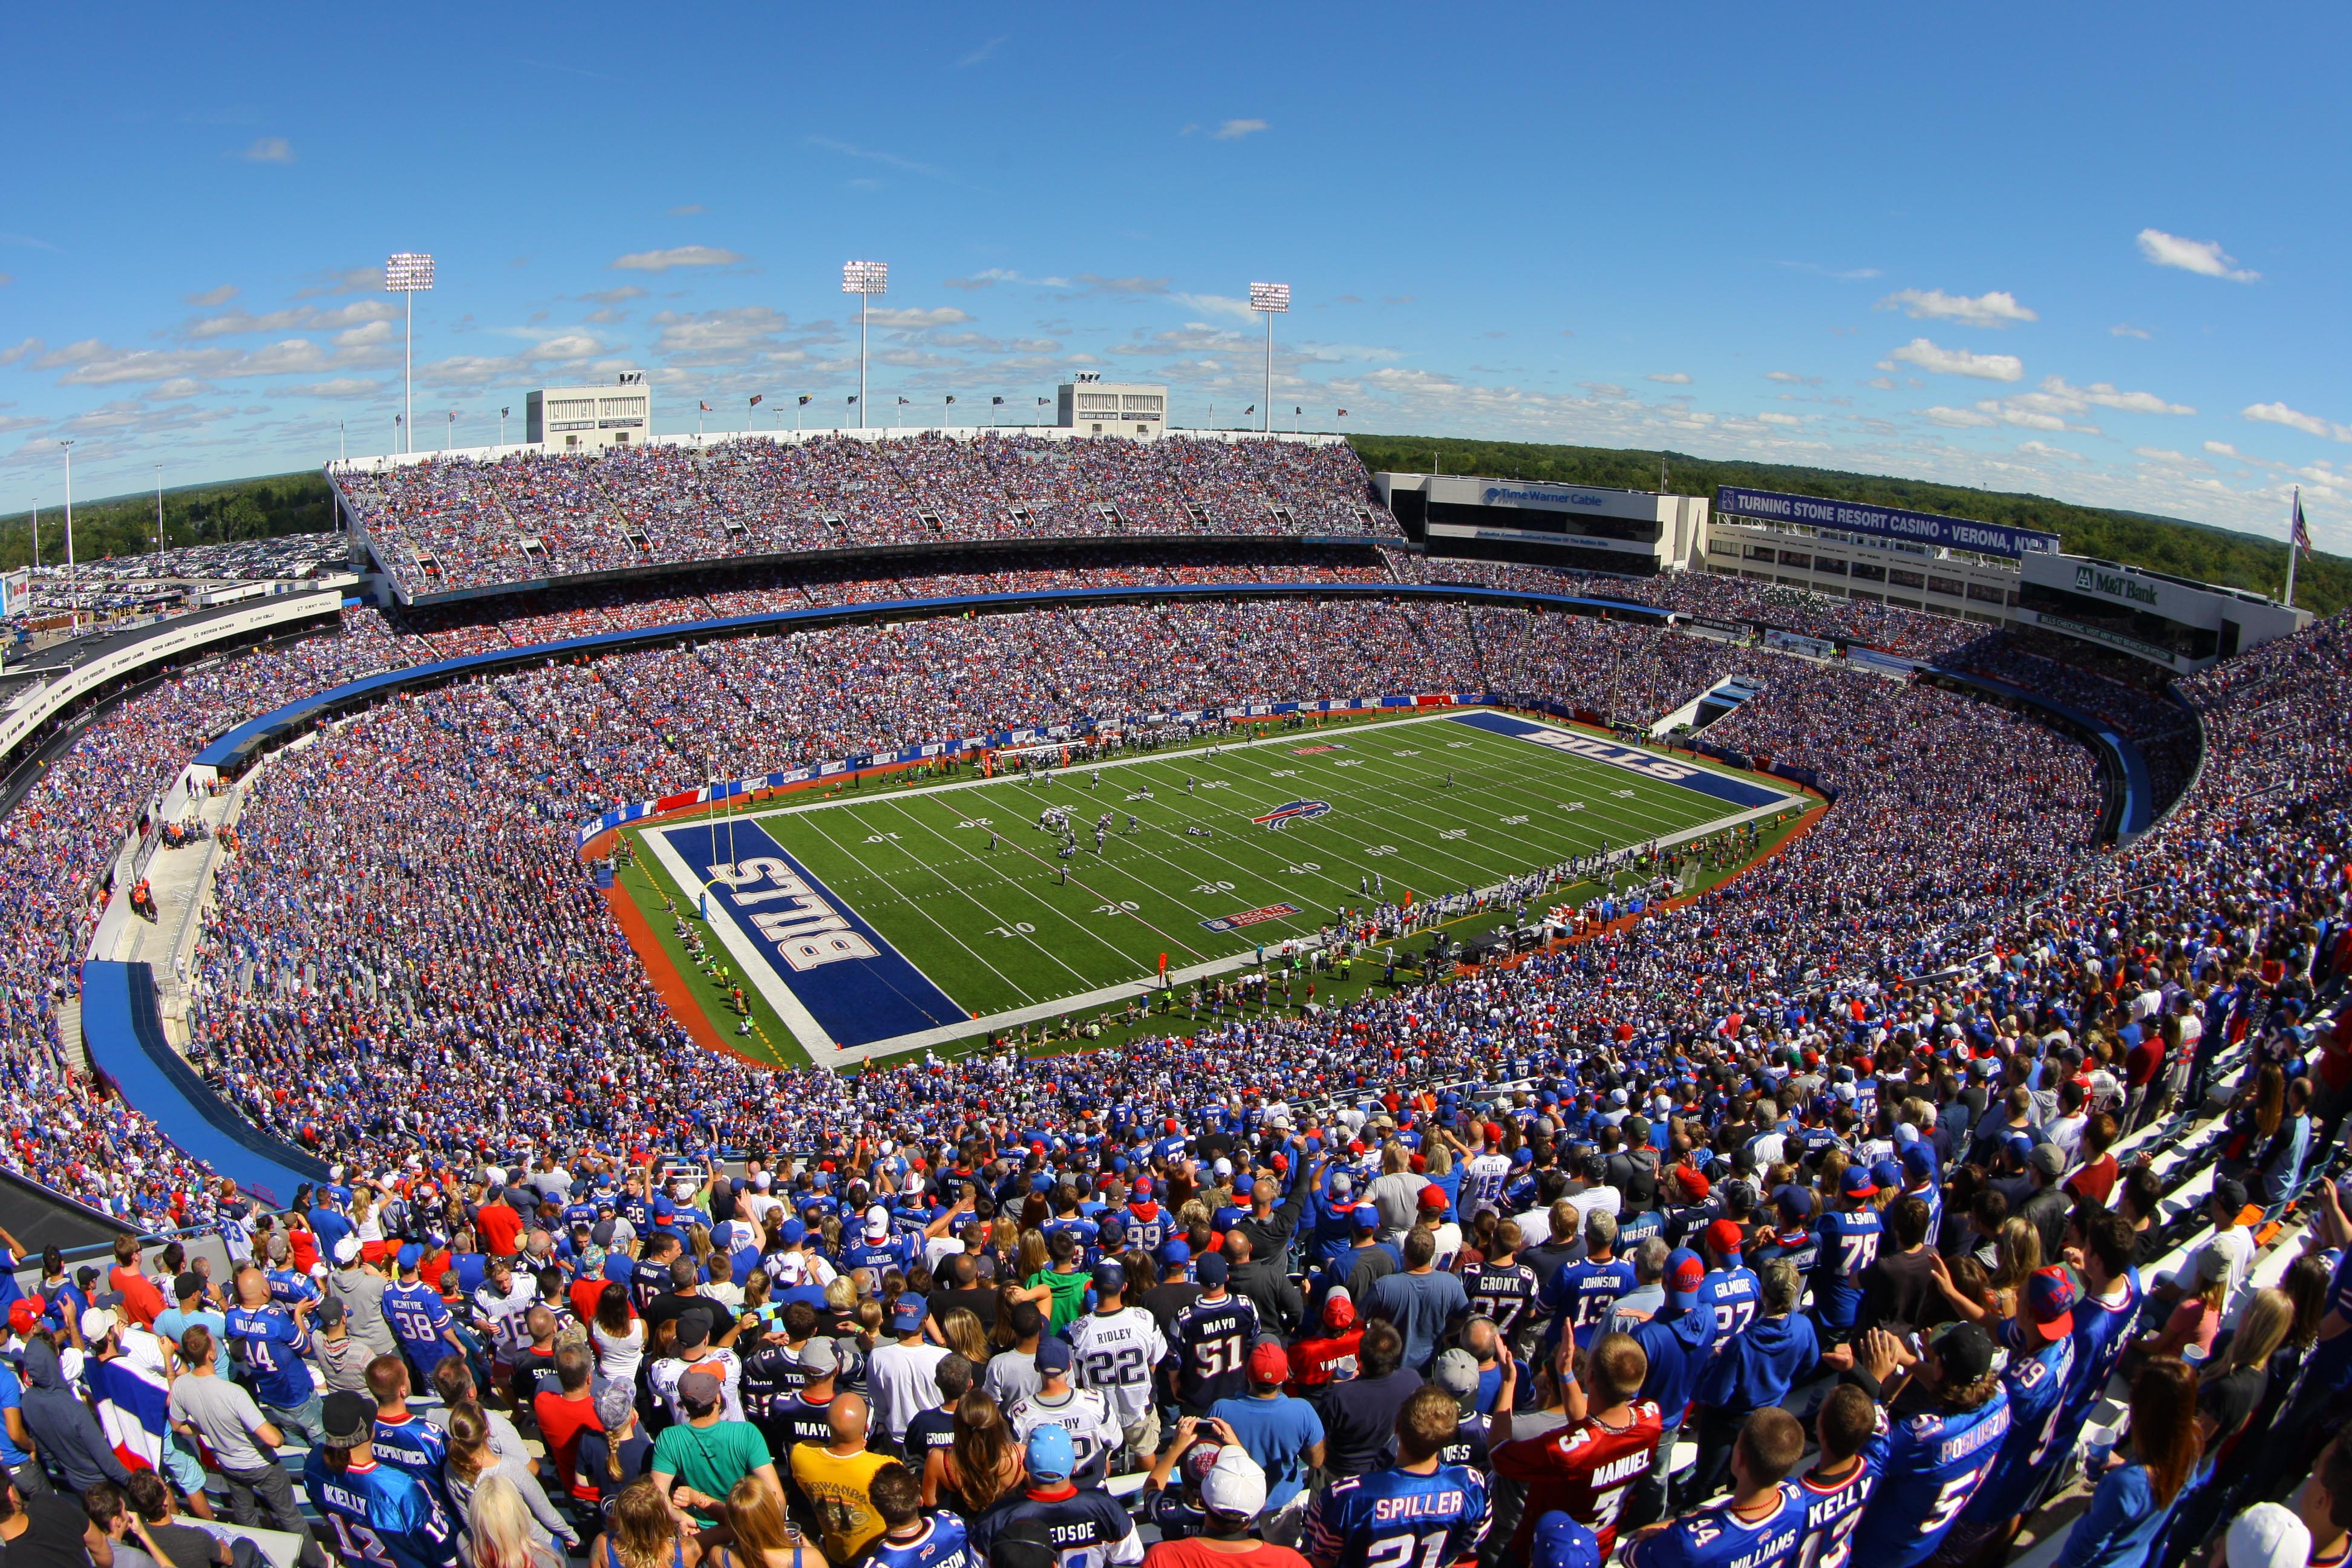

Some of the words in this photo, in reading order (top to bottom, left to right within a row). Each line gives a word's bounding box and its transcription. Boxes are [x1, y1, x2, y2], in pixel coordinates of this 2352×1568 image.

[1500, 488, 1527, 500] Time
[1529, 491, 1569, 503] Warner
[1570, 494, 1602, 506] Cable
[1737, 495, 1791, 515] TURNING
[1794, 502, 1834, 521] STONE
[1837, 508, 1887, 528] RESORT
[1890, 516, 1939, 537] CASINO
[1952, 525, 2010, 552] VERONA,
[2015, 536, 2033, 551] NY
[2096, 572, 2125, 596] M&T
[2125, 579, 2158, 606] Bank
[2042, 615, 2056, 625] BILLS
[196, 658, 221, 670] ROCKPILE
[353, 665, 391, 680] ROCKPILE
[208, 720, 234, 738] ROCKPILE
[1516, 730, 1699, 780] BILLS
[1609, 789, 1633, 799] 10
[1557, 802, 1583, 813] 20
[581, 817, 603, 842] BILLS
[959, 818, 993, 828] 20
[1500, 815, 1528, 826] 30
[866, 832, 903, 843] 10
[1439, 829, 1466, 841] 40
[1364, 844, 1399, 858] 50
[1287, 862, 1321, 875] 40
[1195, 880, 1235, 895] 30
[706, 857, 881, 972] BILLS
[1097, 900, 1140, 916] 20
[1230, 909, 1266, 921] BACK
[1238, 910, 1292, 926] FOOTBALL
[991, 922, 1036, 938] 10
[1858, 1088, 1875, 1097] JOHNS
[1482, 1164, 1503, 1172] KELLY
[1477, 1175, 1505, 1199] 12
[625, 1206, 645, 1224] 28
[673, 1214, 695, 1223] JACKSON
[1845, 1212, 1877, 1224] B.SMITH
[222, 1217, 244, 1243] 83
[1127, 1227, 1160, 1250] 99
[864, 1253, 893, 1264] DAREUS
[1840, 1233, 1879, 1276] 78
[639, 1267, 659, 1279] BRADY
[269, 1281, 289, 1293] LYNCH
[1480, 1276, 1520, 1292] GRONK
[1579, 1276, 1621, 1290] JOHNSON
[1714, 1278, 1751, 1298] GILMORE
[392, 1299, 424, 1312] MCINTYRE
[1203, 1317, 1236, 1335] MAYO
[1714, 1300, 1756, 1336] 27
[395, 1312, 437, 1343] 38
[1097, 1327, 1132, 1345] RIDLEY
[1195, 1335, 1244, 1379] 51
[1085, 1347, 1147, 1386] 22
[2010, 1356, 2048, 1390] 99
[785, 1374, 805, 1384] TEB
[420, 1422, 443, 1446] 14
[1911, 1414, 1944, 1443] 51
[1559, 1427, 1592, 1452] 3
[1590, 1448, 1650, 1489] MANUEL
[323, 1482, 367, 1517] KELLY
[1376, 1491, 1463, 1520] SPILLER
[1808, 1476, 1873, 1528] KELLY
[425, 1509, 451, 1544] 12
[1050, 1521, 1096, 1544] EDSOE
[1687, 1518, 1722, 1549] 94
[327, 1512, 399, 1568] 12
[1367, 1530, 1450, 1568] 21
[1730, 1528, 1797, 1568] WILLIAMS
